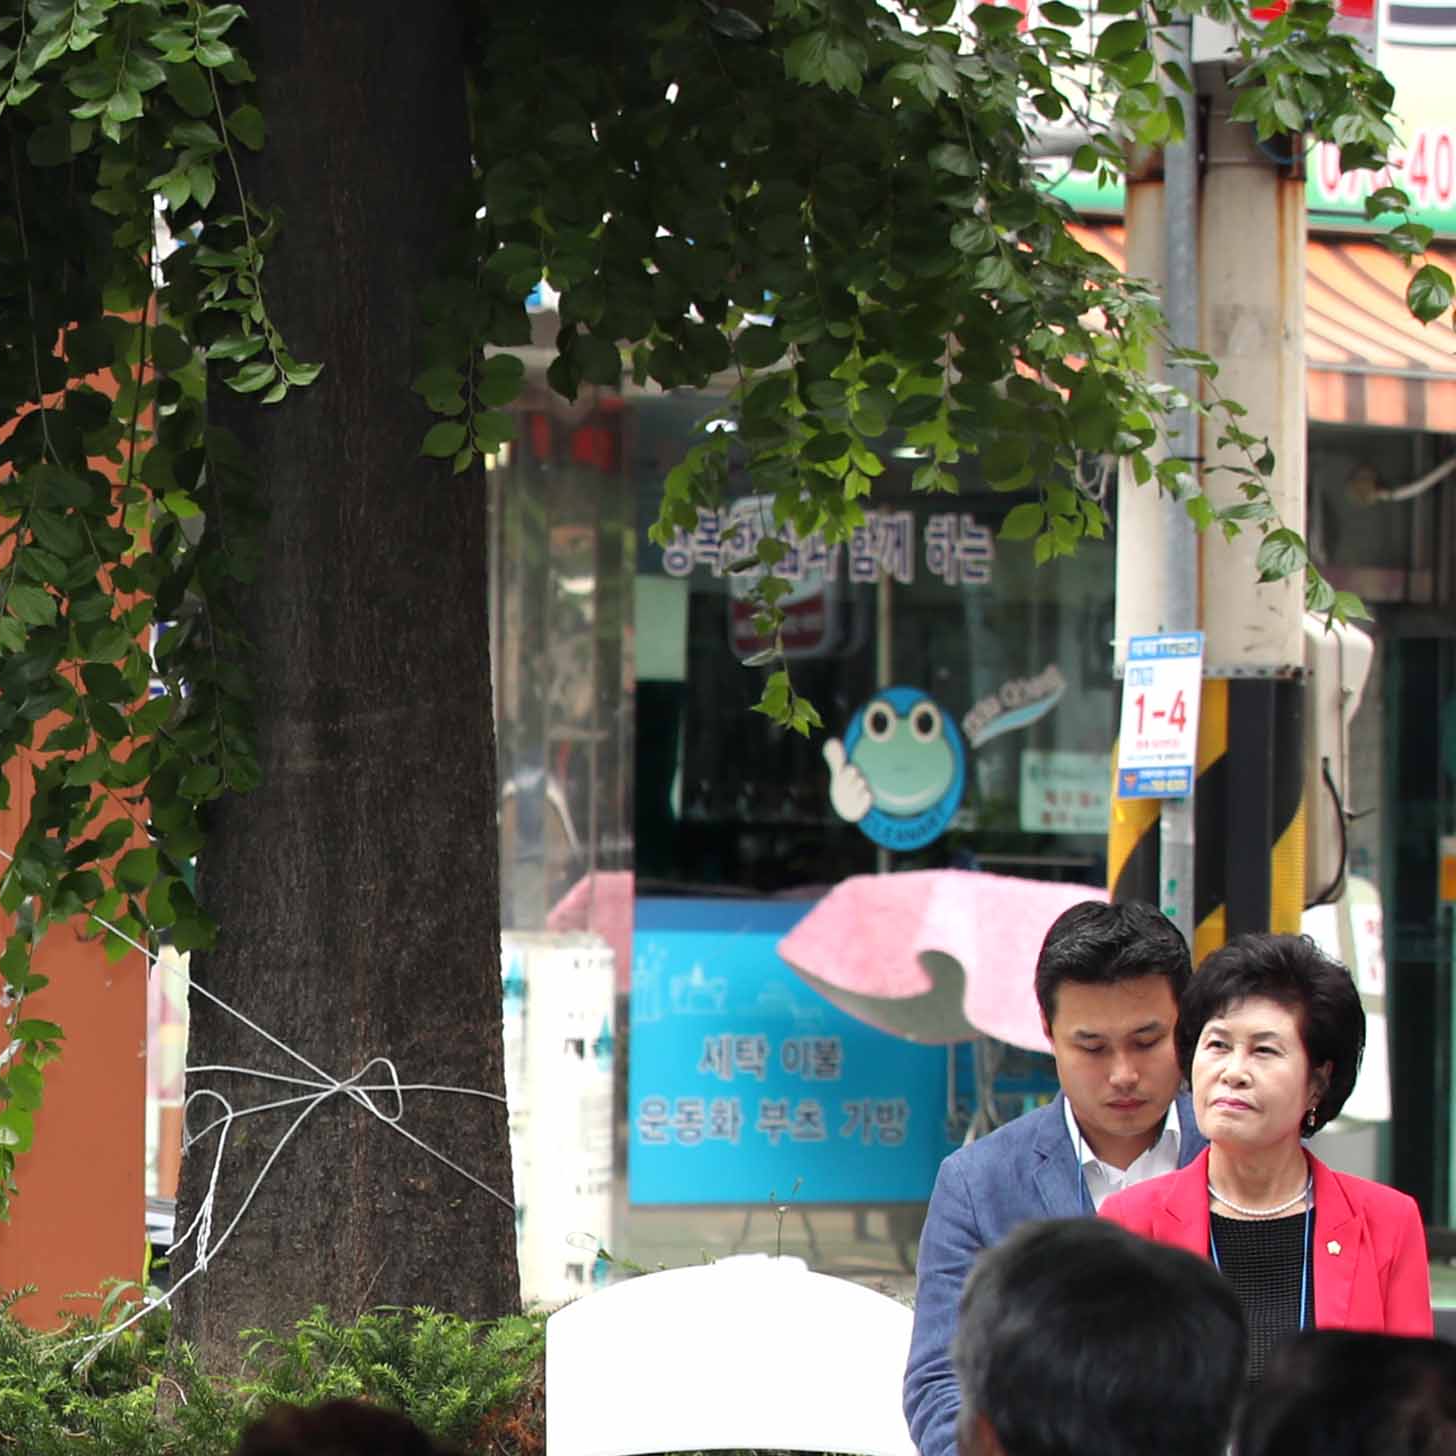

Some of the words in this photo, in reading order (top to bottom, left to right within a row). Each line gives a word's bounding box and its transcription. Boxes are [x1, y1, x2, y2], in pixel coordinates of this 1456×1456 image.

[1135, 690, 1187, 734] 1-4
[700, 1032, 769, 1081] 세탁
[782, 1033, 843, 1081] 이불
[637, 1096, 743, 1146] 운동화
[757, 1099, 827, 1146] 부츠
[840, 1099, 910, 1146] 가방
